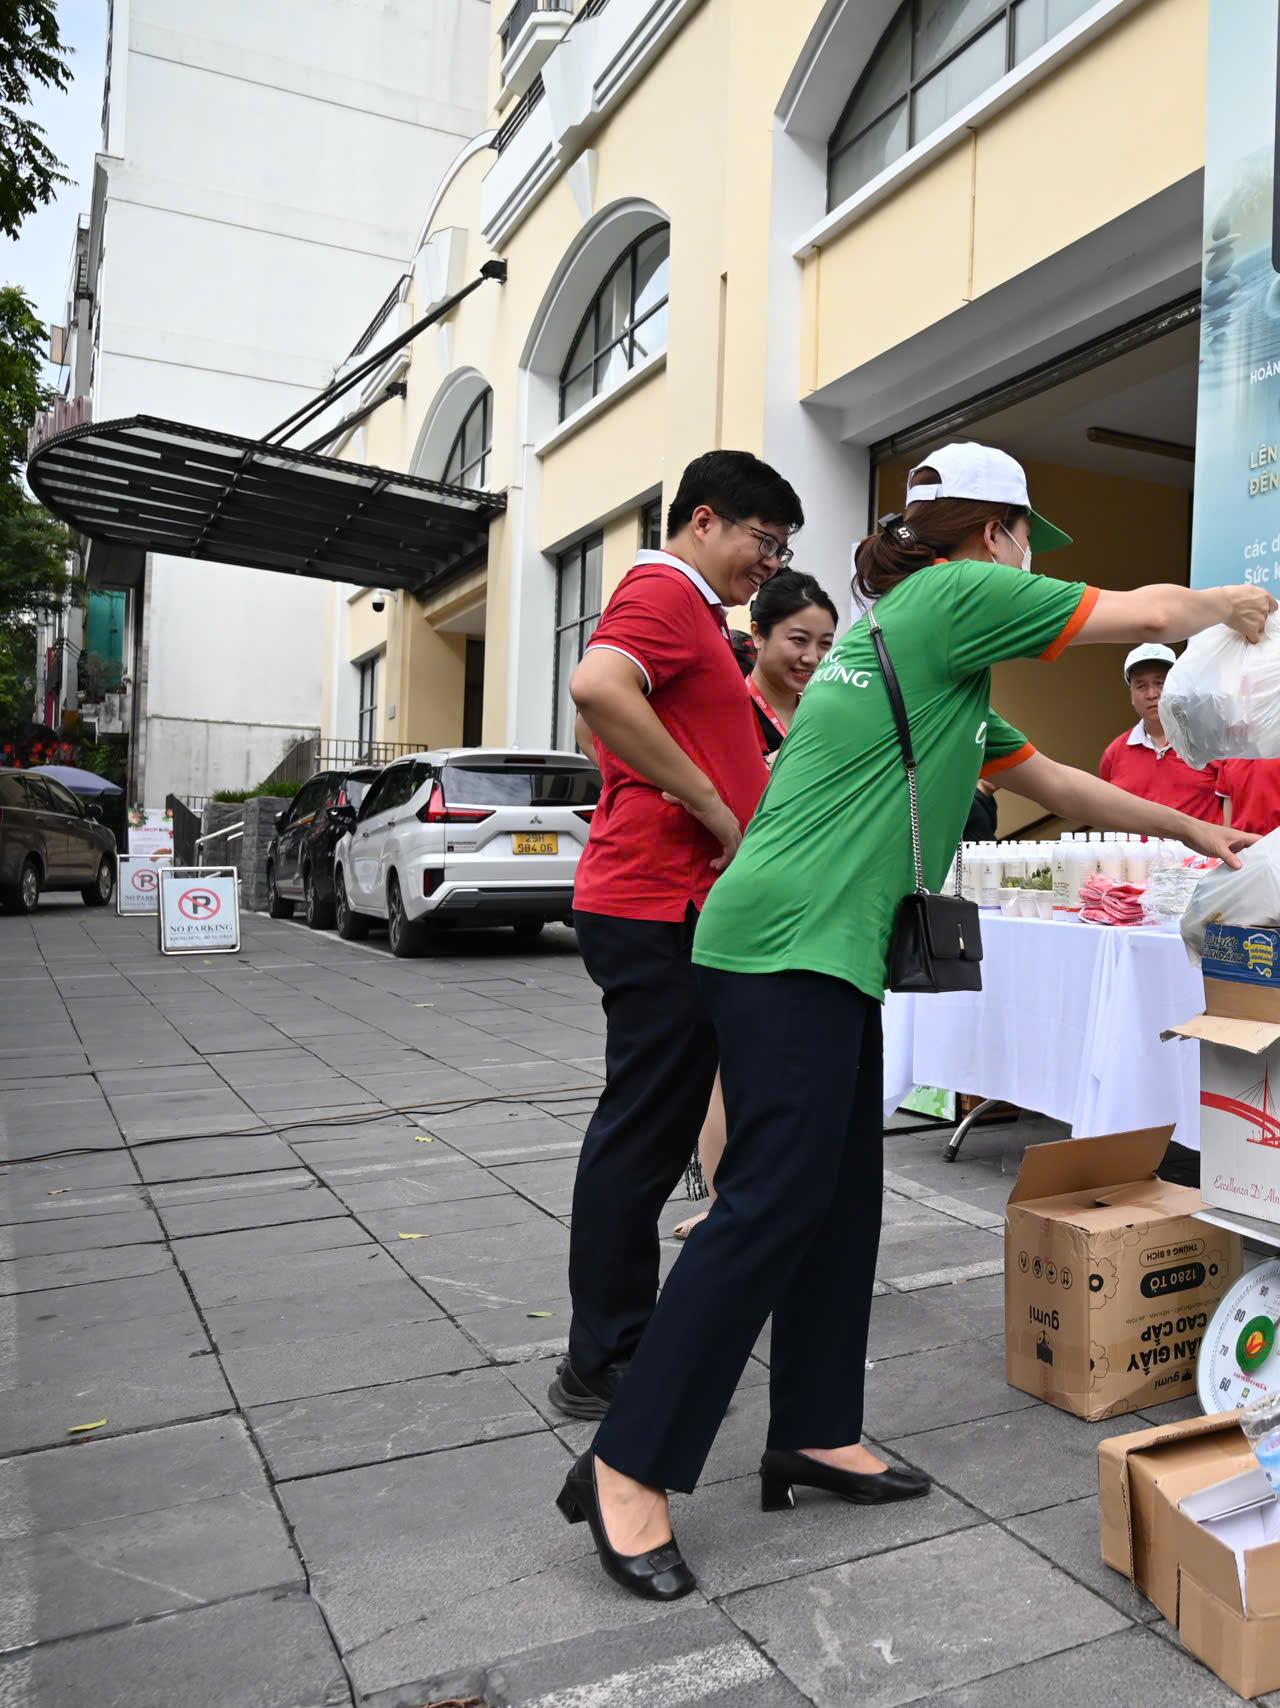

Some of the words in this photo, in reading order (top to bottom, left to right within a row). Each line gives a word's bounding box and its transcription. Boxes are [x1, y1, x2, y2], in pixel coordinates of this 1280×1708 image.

[1250, 359, 1280, 384] HOÀN
[1249, 443, 1279, 470] LÊN
[1243, 538, 1268, 560] các
[1243, 564, 1270, 586] Sức
[169, 925, 186, 934] NO
[187, 923, 234, 934] PARKING
[1146, 1249, 1165, 1262] BỊCH
[1172, 1243, 1198, 1256] THÙNG
[1170, 1267, 1197, 1285] 1280
[1259, 1285, 1270, 1297] 90
[1029, 1304, 1060, 1331] gumi
[1175, 1312, 1208, 1334] CAO
[1233, 1308, 1246, 1323] 80
[1140, 1320, 1174, 1346] CẤP
[1173, 1336, 1203, 1361] ĂN
[1219, 1344, 1229, 1357] 70
[1126, 1345, 1171, 1377] GIẤY
[1154, 1371, 1180, 1391] gumi
[1219, 1377, 1232, 1392] 60
